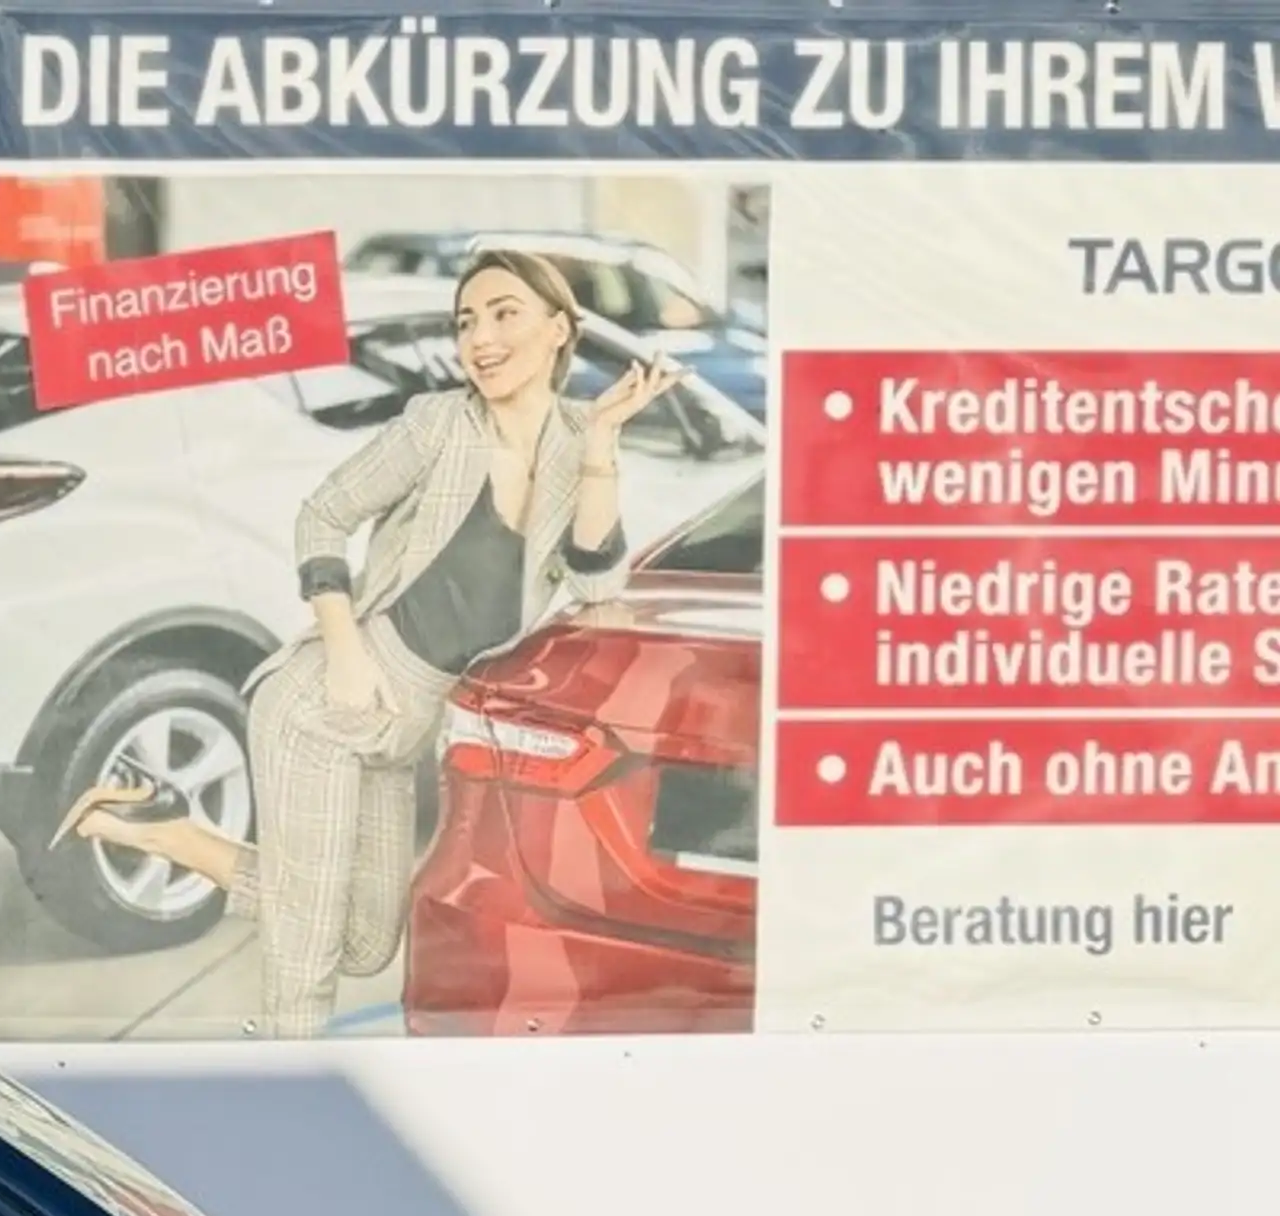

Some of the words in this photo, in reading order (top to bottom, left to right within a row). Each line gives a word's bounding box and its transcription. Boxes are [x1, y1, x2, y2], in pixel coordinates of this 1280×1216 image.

[21, 35, 170, 127] DIE
[195, 16, 759, 128] ABKÜRZUNG
[790, 38, 906, 130] ZU
[940, 40, 1226, 131] IHREM
[50, 261, 318, 329] Finanzierung
[1067, 238, 1280, 295] TARG
[88, 332, 187, 382] nach
[200, 315, 292, 364] Maß
[878, 377, 1280, 434] Kreditentsch
[878, 448, 1136, 516] wenigen
[1160, 448, 1280, 505] Min
[876, 559, 1133, 627] Niedrige
[1156, 560, 1280, 616] Rate
[876, 628, 1231, 686] individuelle
[868, 741, 1022, 796] Auch
[1045, 740, 1192, 795] ohne
[873, 894, 1113, 956] Beratung
[1133, 893, 1233, 944] hier
